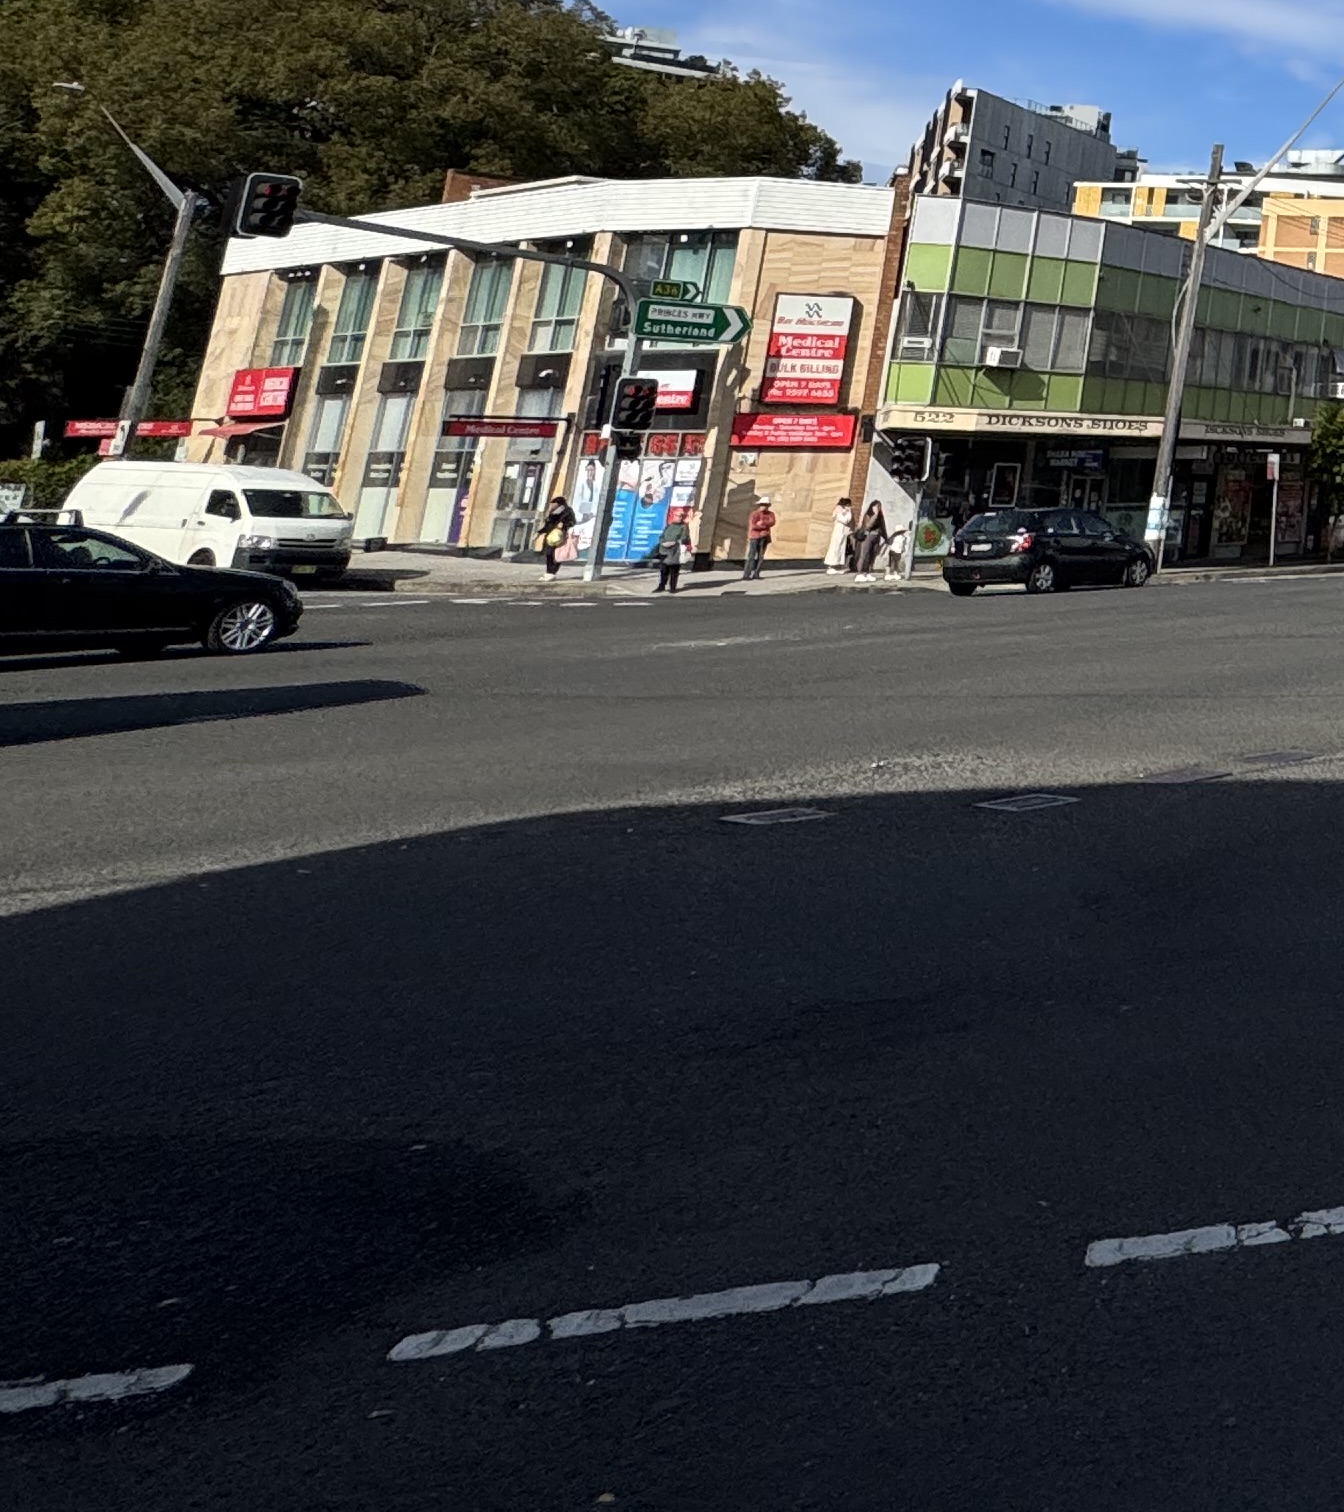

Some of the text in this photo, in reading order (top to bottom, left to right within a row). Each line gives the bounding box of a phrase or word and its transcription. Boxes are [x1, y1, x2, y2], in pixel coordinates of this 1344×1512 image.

[642, 321, 716, 338] Sutherland
[777, 335, 840, 348] Medical
[781, 347, 834, 357] Centre
[769, 362, 798, 374] BULK
[656, 394, 690, 404] entre
[985, 414, 1084, 430] DICKSONS
[1087, 419, 1149, 432] SHOES
[465, 425, 541, 435] Medical Centre
